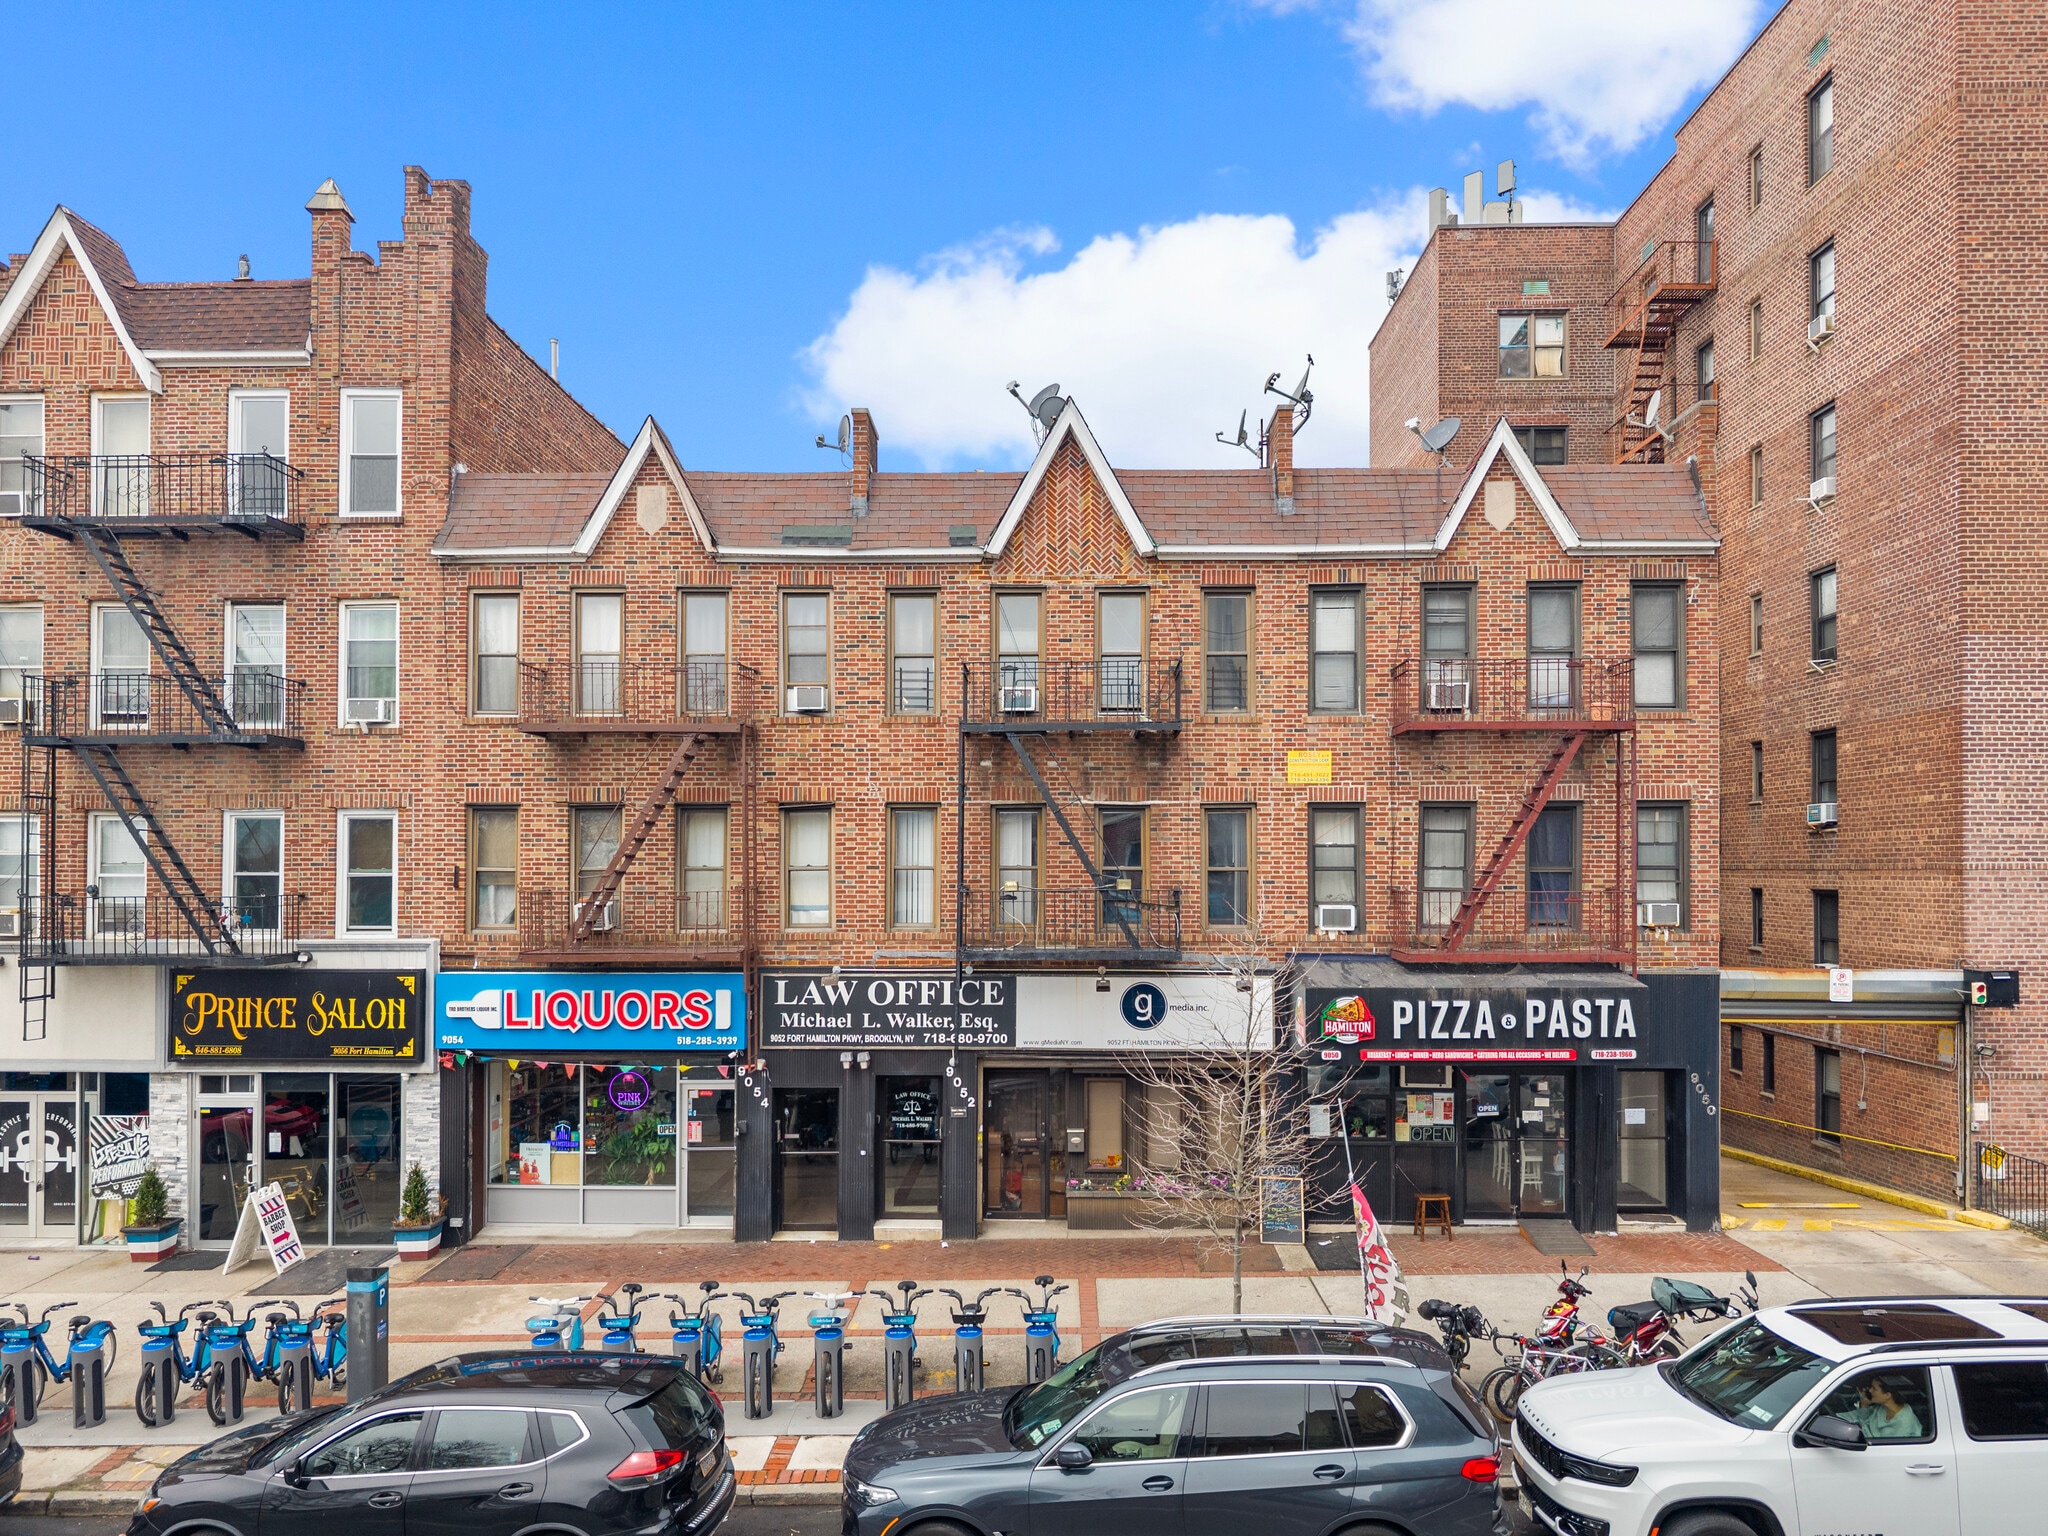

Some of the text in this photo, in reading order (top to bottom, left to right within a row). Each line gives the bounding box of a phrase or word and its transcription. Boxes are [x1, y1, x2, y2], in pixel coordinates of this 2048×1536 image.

[774, 979, 1005, 1006] LAW OFFICE
[503, 989, 713, 1034] LIQUORS
[1134, 993, 1153, 1021] g
[1169, 1003, 1194, 1012] media
[183, 990, 406, 1040] PRINCE SALON
[780, 1012, 999, 1032] Michael L. Walker, Esq.
[1393, 999, 1496, 1040] PIZZA
[1526, 998, 1637, 1039] PASTA
[1325, 1021, 1371, 1033] HAMILTON
[441, 1035, 464, 1044] 9054
[676, 1036, 738, 1045] 518-285-3939
[770, 1034, 915, 1044] 9052 FORT HAMILTON PKWY, BROOKLYN, NY
[738, 1066, 769, 1108] 9054
[946, 1066, 976, 1107] 9052
[617, 1092, 641, 1102] PINK
[895, 1091, 931, 1100] LAW OFFICE
[659, 1125, 677, 1134] OPEN
[1411, 1127, 1453, 1141] OPEN
[263, 1208, 287, 1226] BARBER
[270, 1220, 286, 1234] SHOP
